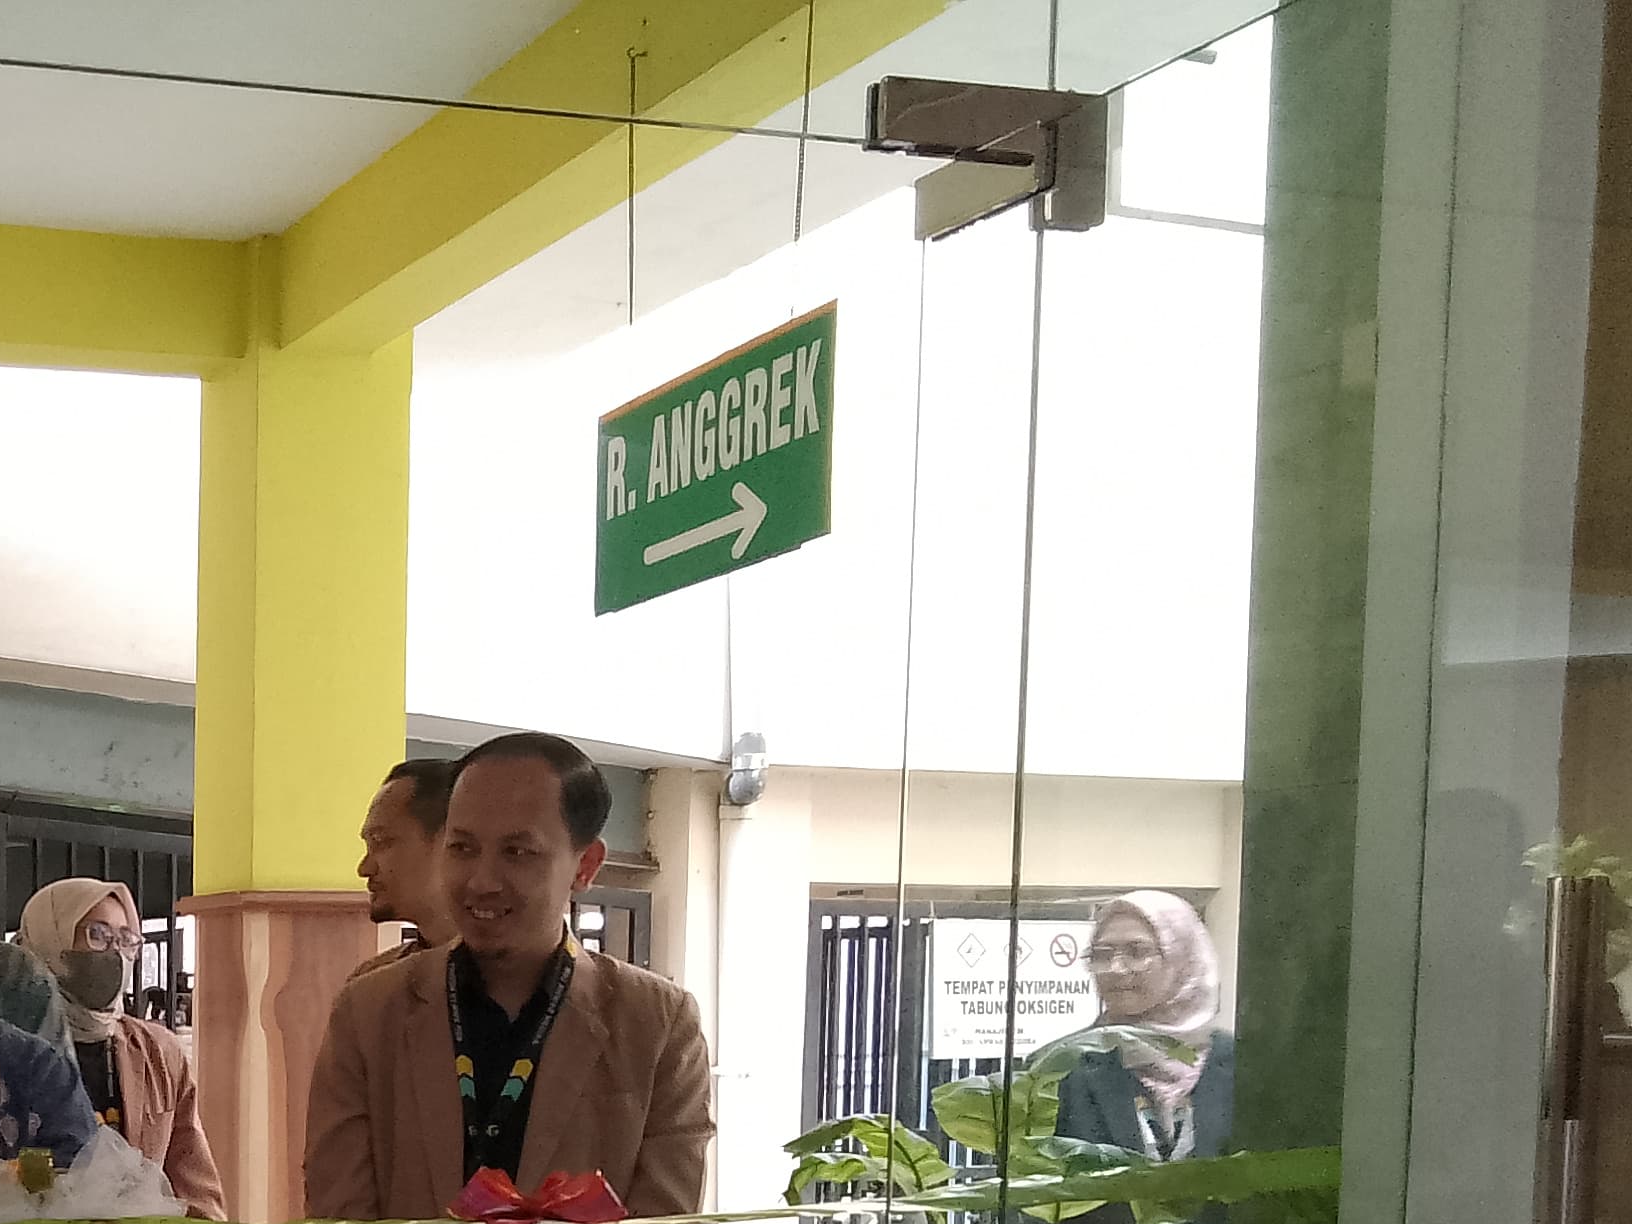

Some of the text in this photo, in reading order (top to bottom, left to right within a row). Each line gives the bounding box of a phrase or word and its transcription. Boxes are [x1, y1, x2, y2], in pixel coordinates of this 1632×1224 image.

[606, 338, 823, 520] R. ANGGREK
[944, 980, 1091, 995] TEMPAT PNYIMPANAN
[1016, 1000, 1075, 1015] OKSIGEN
